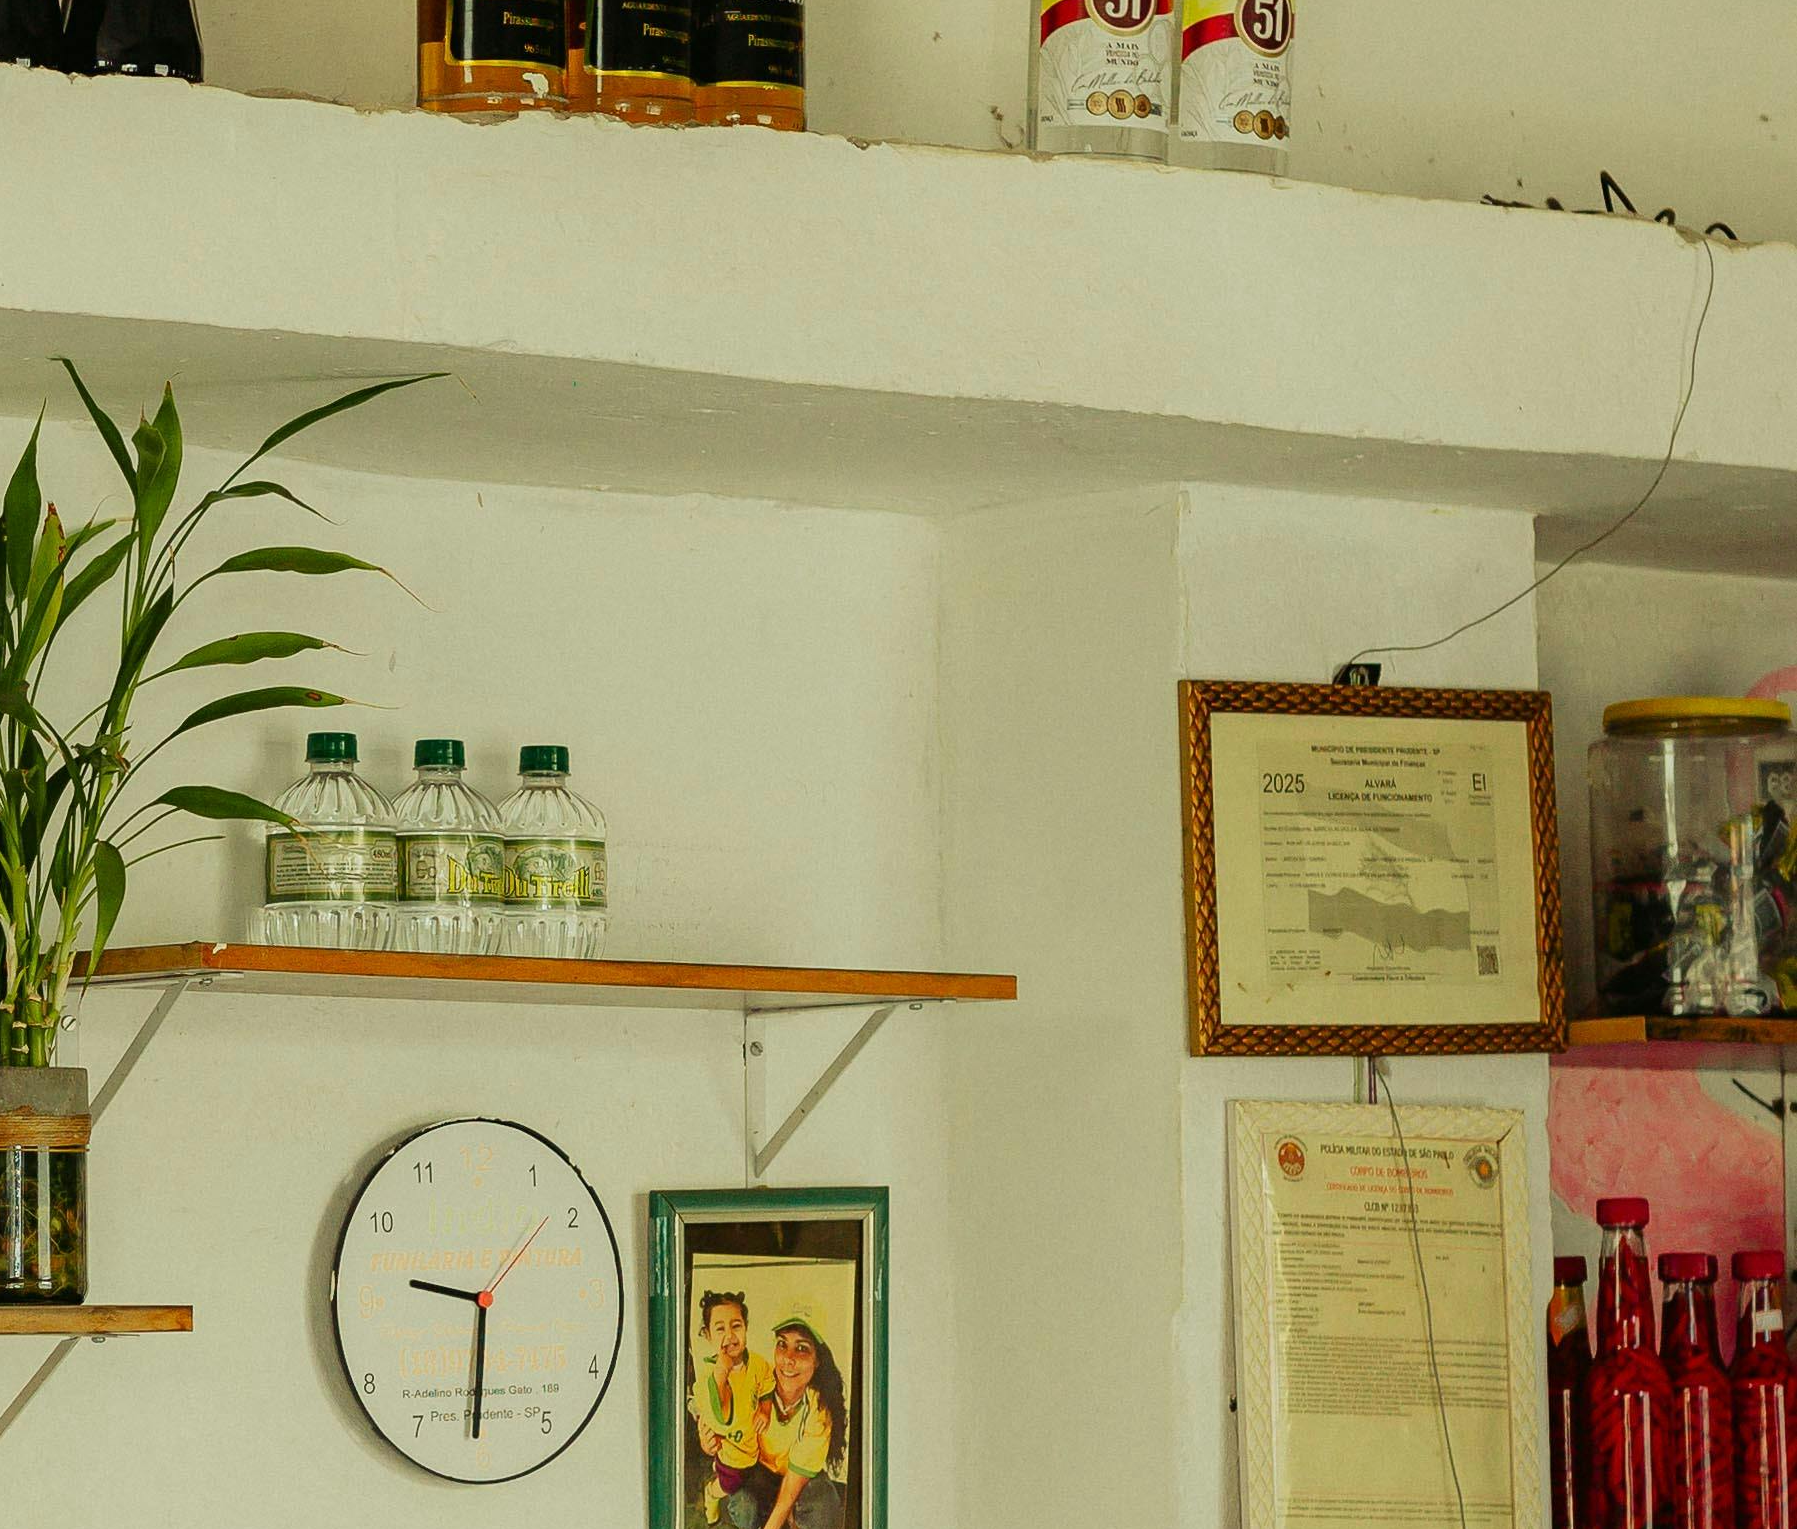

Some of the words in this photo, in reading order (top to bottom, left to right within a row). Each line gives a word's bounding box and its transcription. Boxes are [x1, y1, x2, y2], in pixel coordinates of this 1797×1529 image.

[1262, 772, 1305, 794] 2025
[1364, 777, 1397, 789] ALVARÁ
[1327, 792, 1360, 803] LICENÇA
[1361, 792, 1372, 802] DE
[1373, 792, 1433, 803] FUNCIONAMENTO
[412, 1160, 436, 1185] 11
[527, 1163, 538, 1189] 1
[369, 1211, 395, 1235] 10
[566, 1206, 579, 1230] 2
[480, 1249, 492, 1269] E
[587, 1352, 600, 1380] 4
[363, 1372, 376, 1394] 8
[508, 1384, 532, 1395] Gato
[412, 1414, 424, 1438] 7
[430, 1410, 460, 1422] Pres.
[524, 1406, 541, 1418] SP
[539, 1410, 552, 1435] 5
